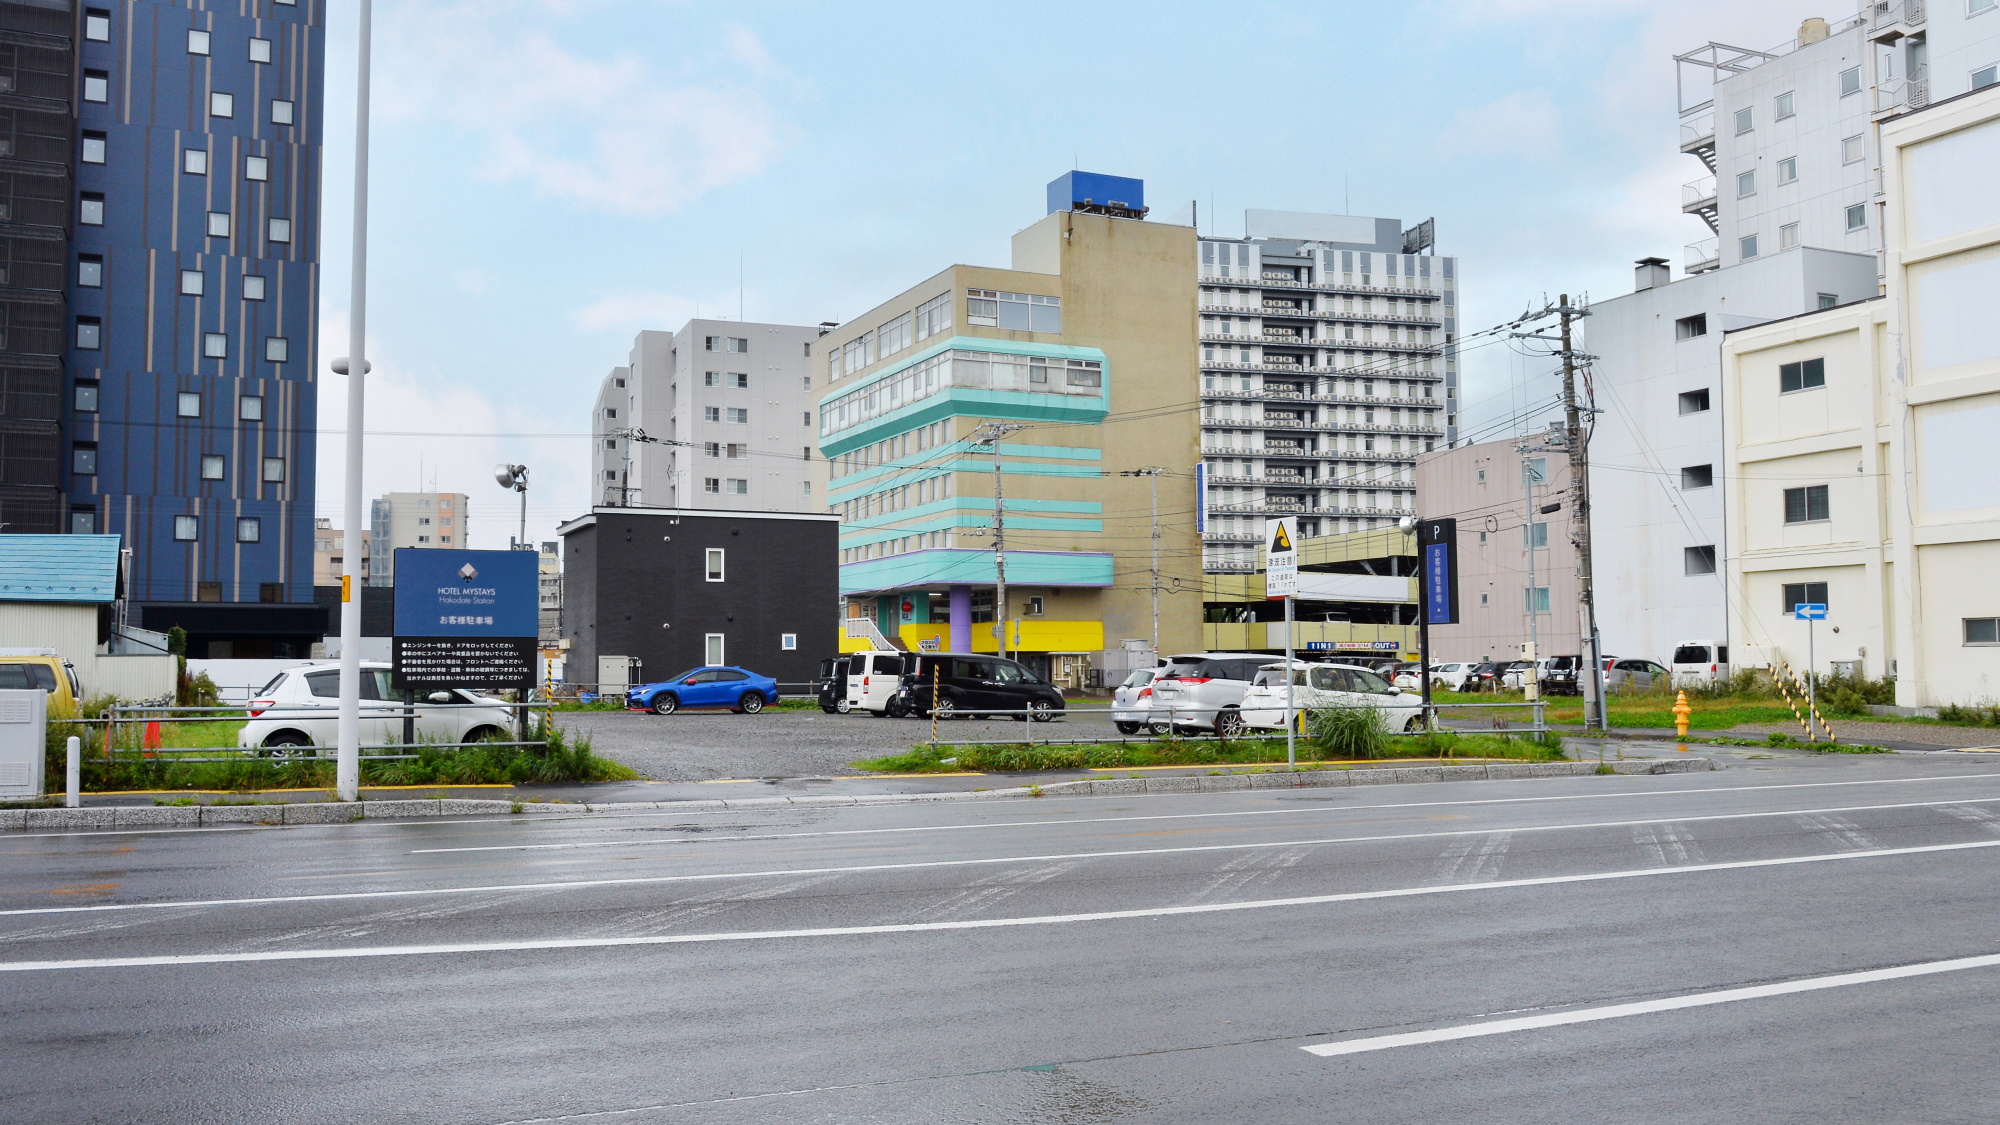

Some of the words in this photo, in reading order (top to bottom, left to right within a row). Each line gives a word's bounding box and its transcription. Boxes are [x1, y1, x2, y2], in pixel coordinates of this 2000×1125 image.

[1434, 525, 1440, 540] P
[440, 616, 493, 625] お客様駐車場
